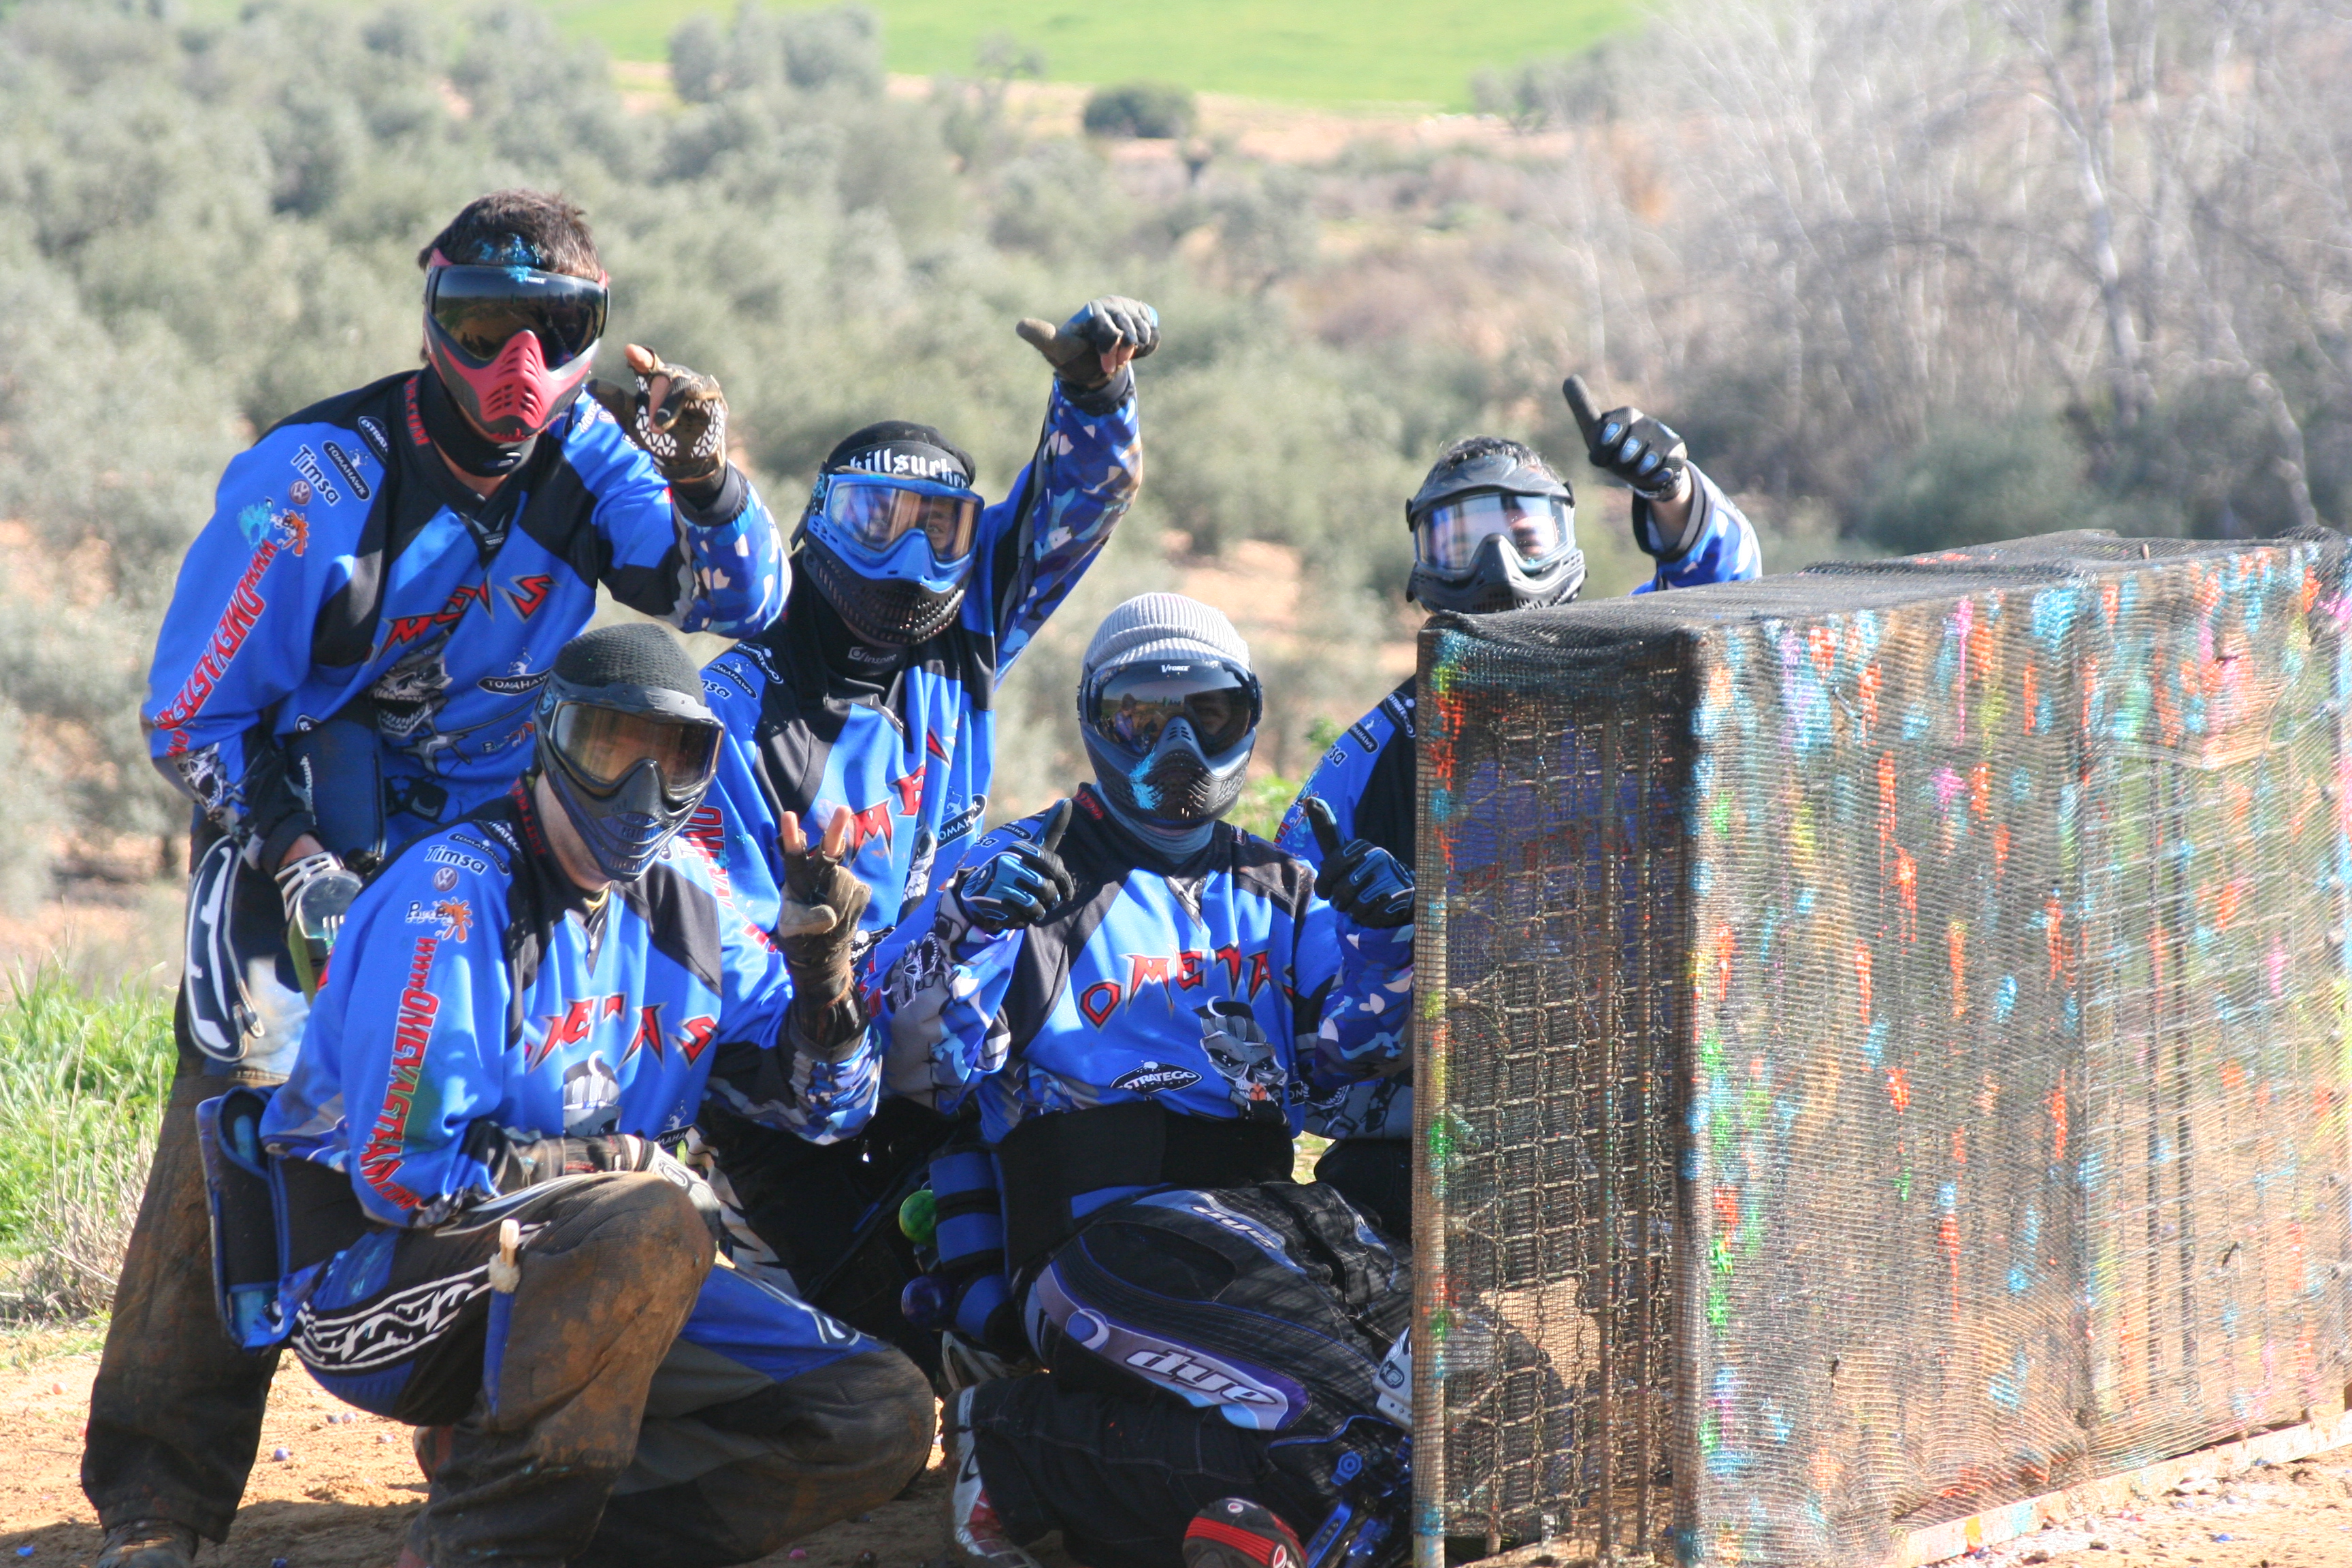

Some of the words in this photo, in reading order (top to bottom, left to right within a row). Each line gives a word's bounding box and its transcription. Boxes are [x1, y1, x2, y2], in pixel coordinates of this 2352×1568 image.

[291, 443, 341, 506] Timsa
[328, 444, 365, 496] TOMAHAWK
[423, 843, 489, 876] Timsa
